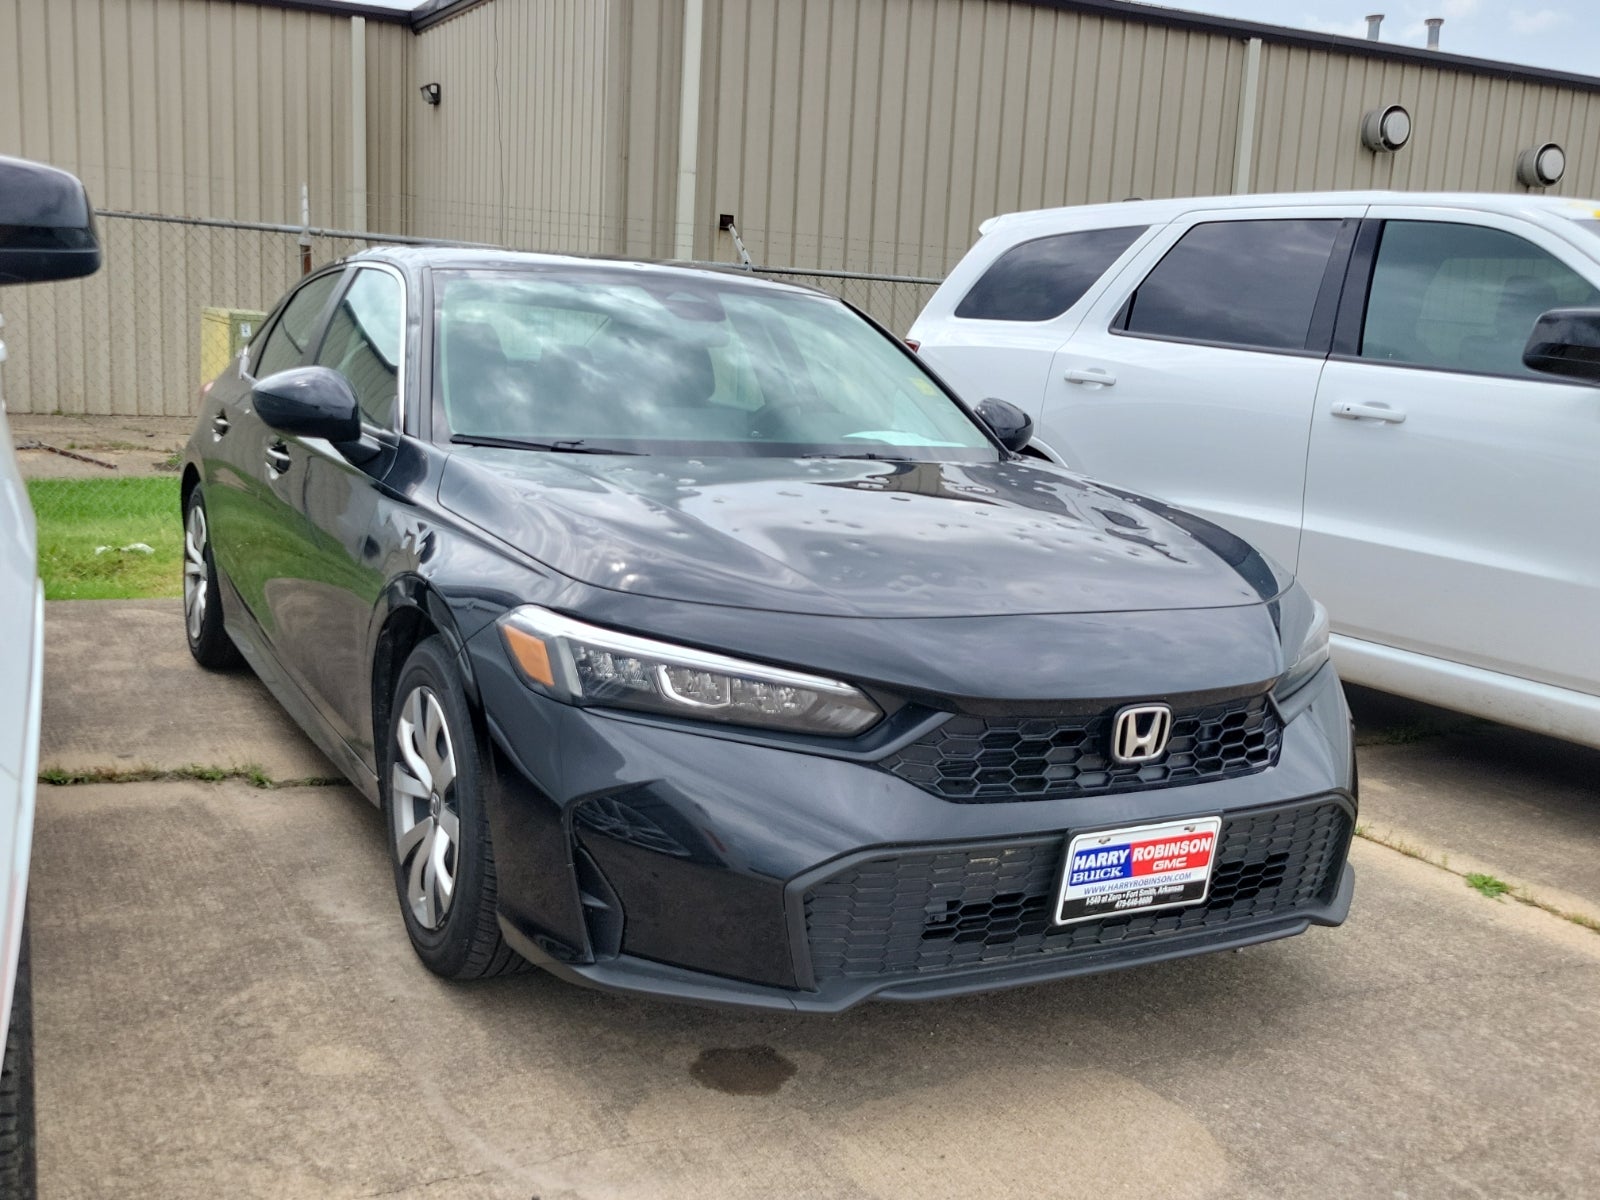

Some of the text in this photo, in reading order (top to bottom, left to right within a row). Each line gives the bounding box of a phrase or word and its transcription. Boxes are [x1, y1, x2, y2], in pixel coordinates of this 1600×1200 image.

[1073, 837, 1213, 871] HARRY ROBINSON
[1152, 856, 1187, 871] GMC
[1071, 866, 1123, 884] BUICK
[1084, 871, 1192, 895] WWW.HARRYROBINSON.COM
[1126, 890, 1139, 900] Fort
